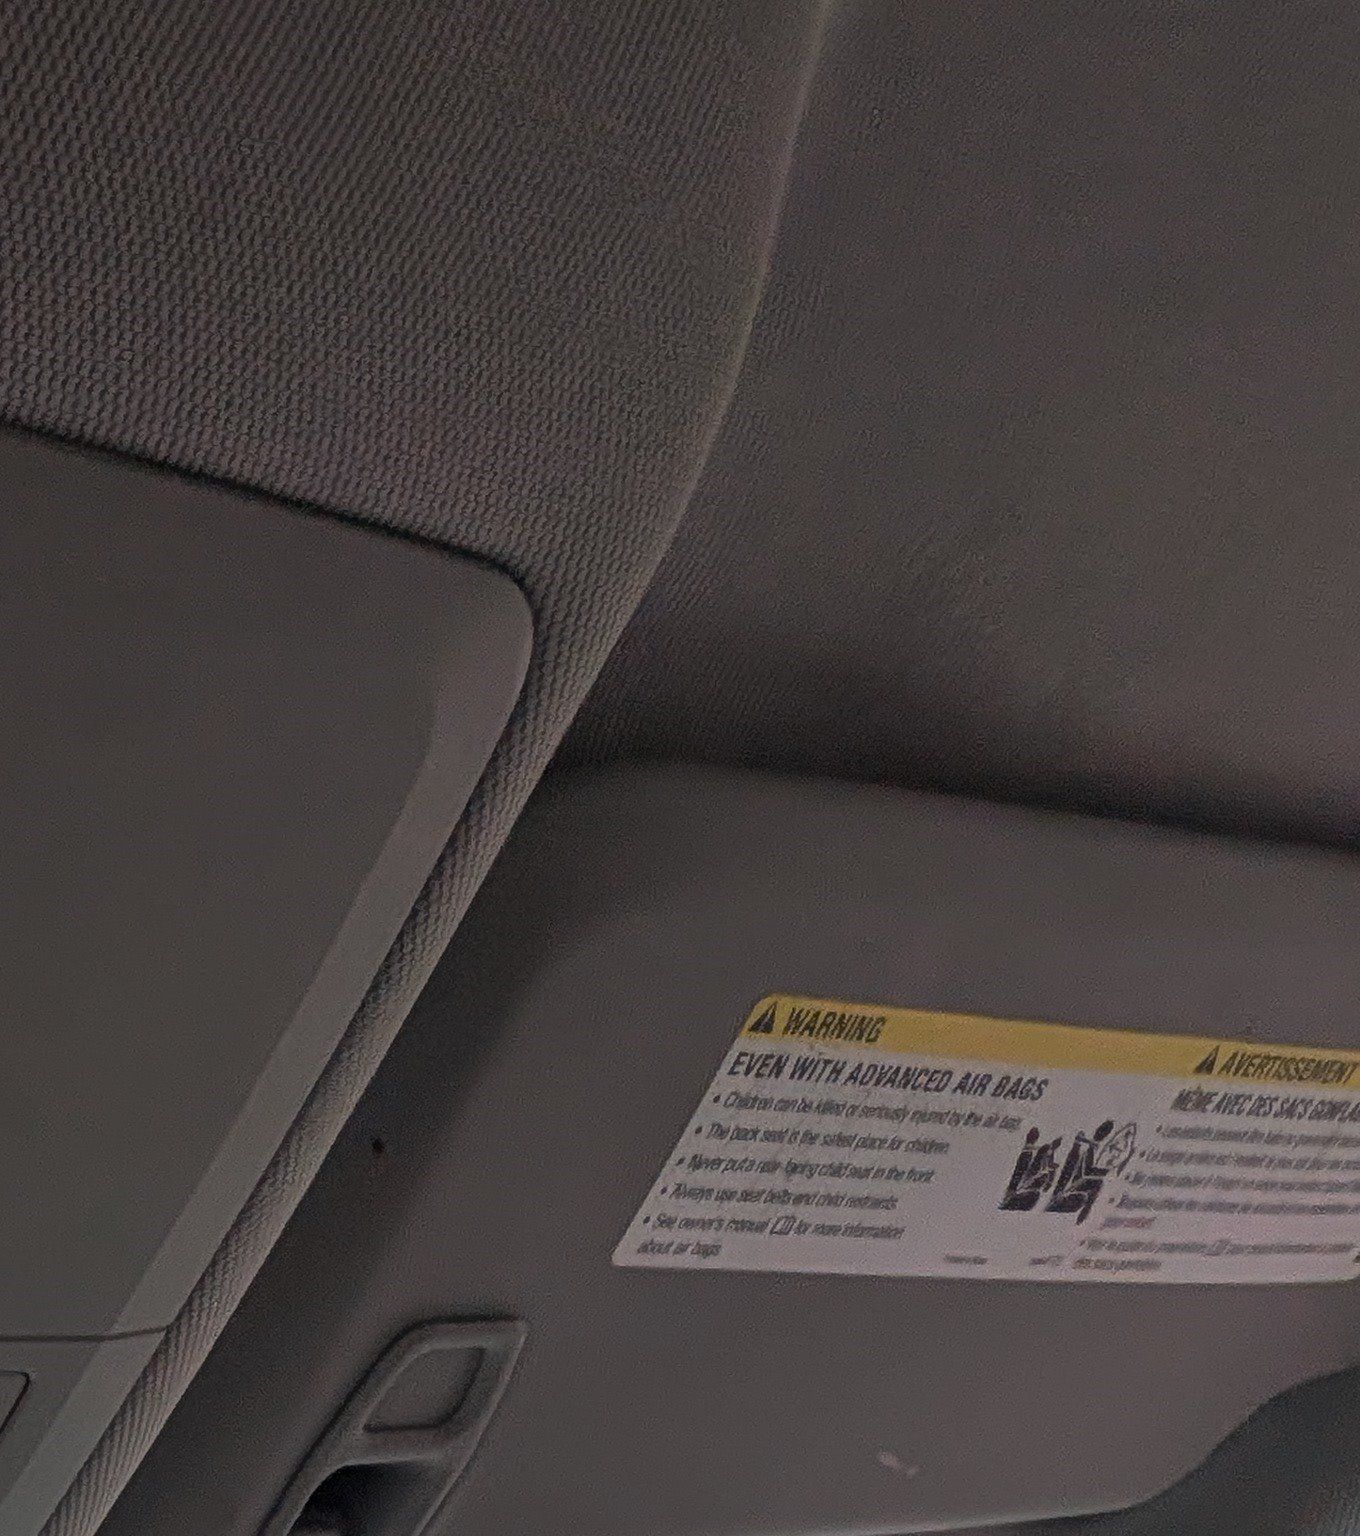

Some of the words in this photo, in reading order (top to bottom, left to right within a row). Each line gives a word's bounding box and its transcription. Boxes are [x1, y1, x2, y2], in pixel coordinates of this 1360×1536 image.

[782, 1006, 886, 1043] WARNING
[727, 1051, 791, 1080] EVEN
[789, 1055, 848, 1085] WITH
[843, 1061, 955, 1094] ADVANCED
[952, 1072, 993, 1097] AIR
[991, 1074, 1050, 1102] BAGS
[1217, 1049, 1360, 1085] AVERTISSEMENT
[1211, 1091, 1254, 1116] AVEC
[1246, 1094, 1280, 1118] DES
[1273, 1096, 1315, 1121] SACS
